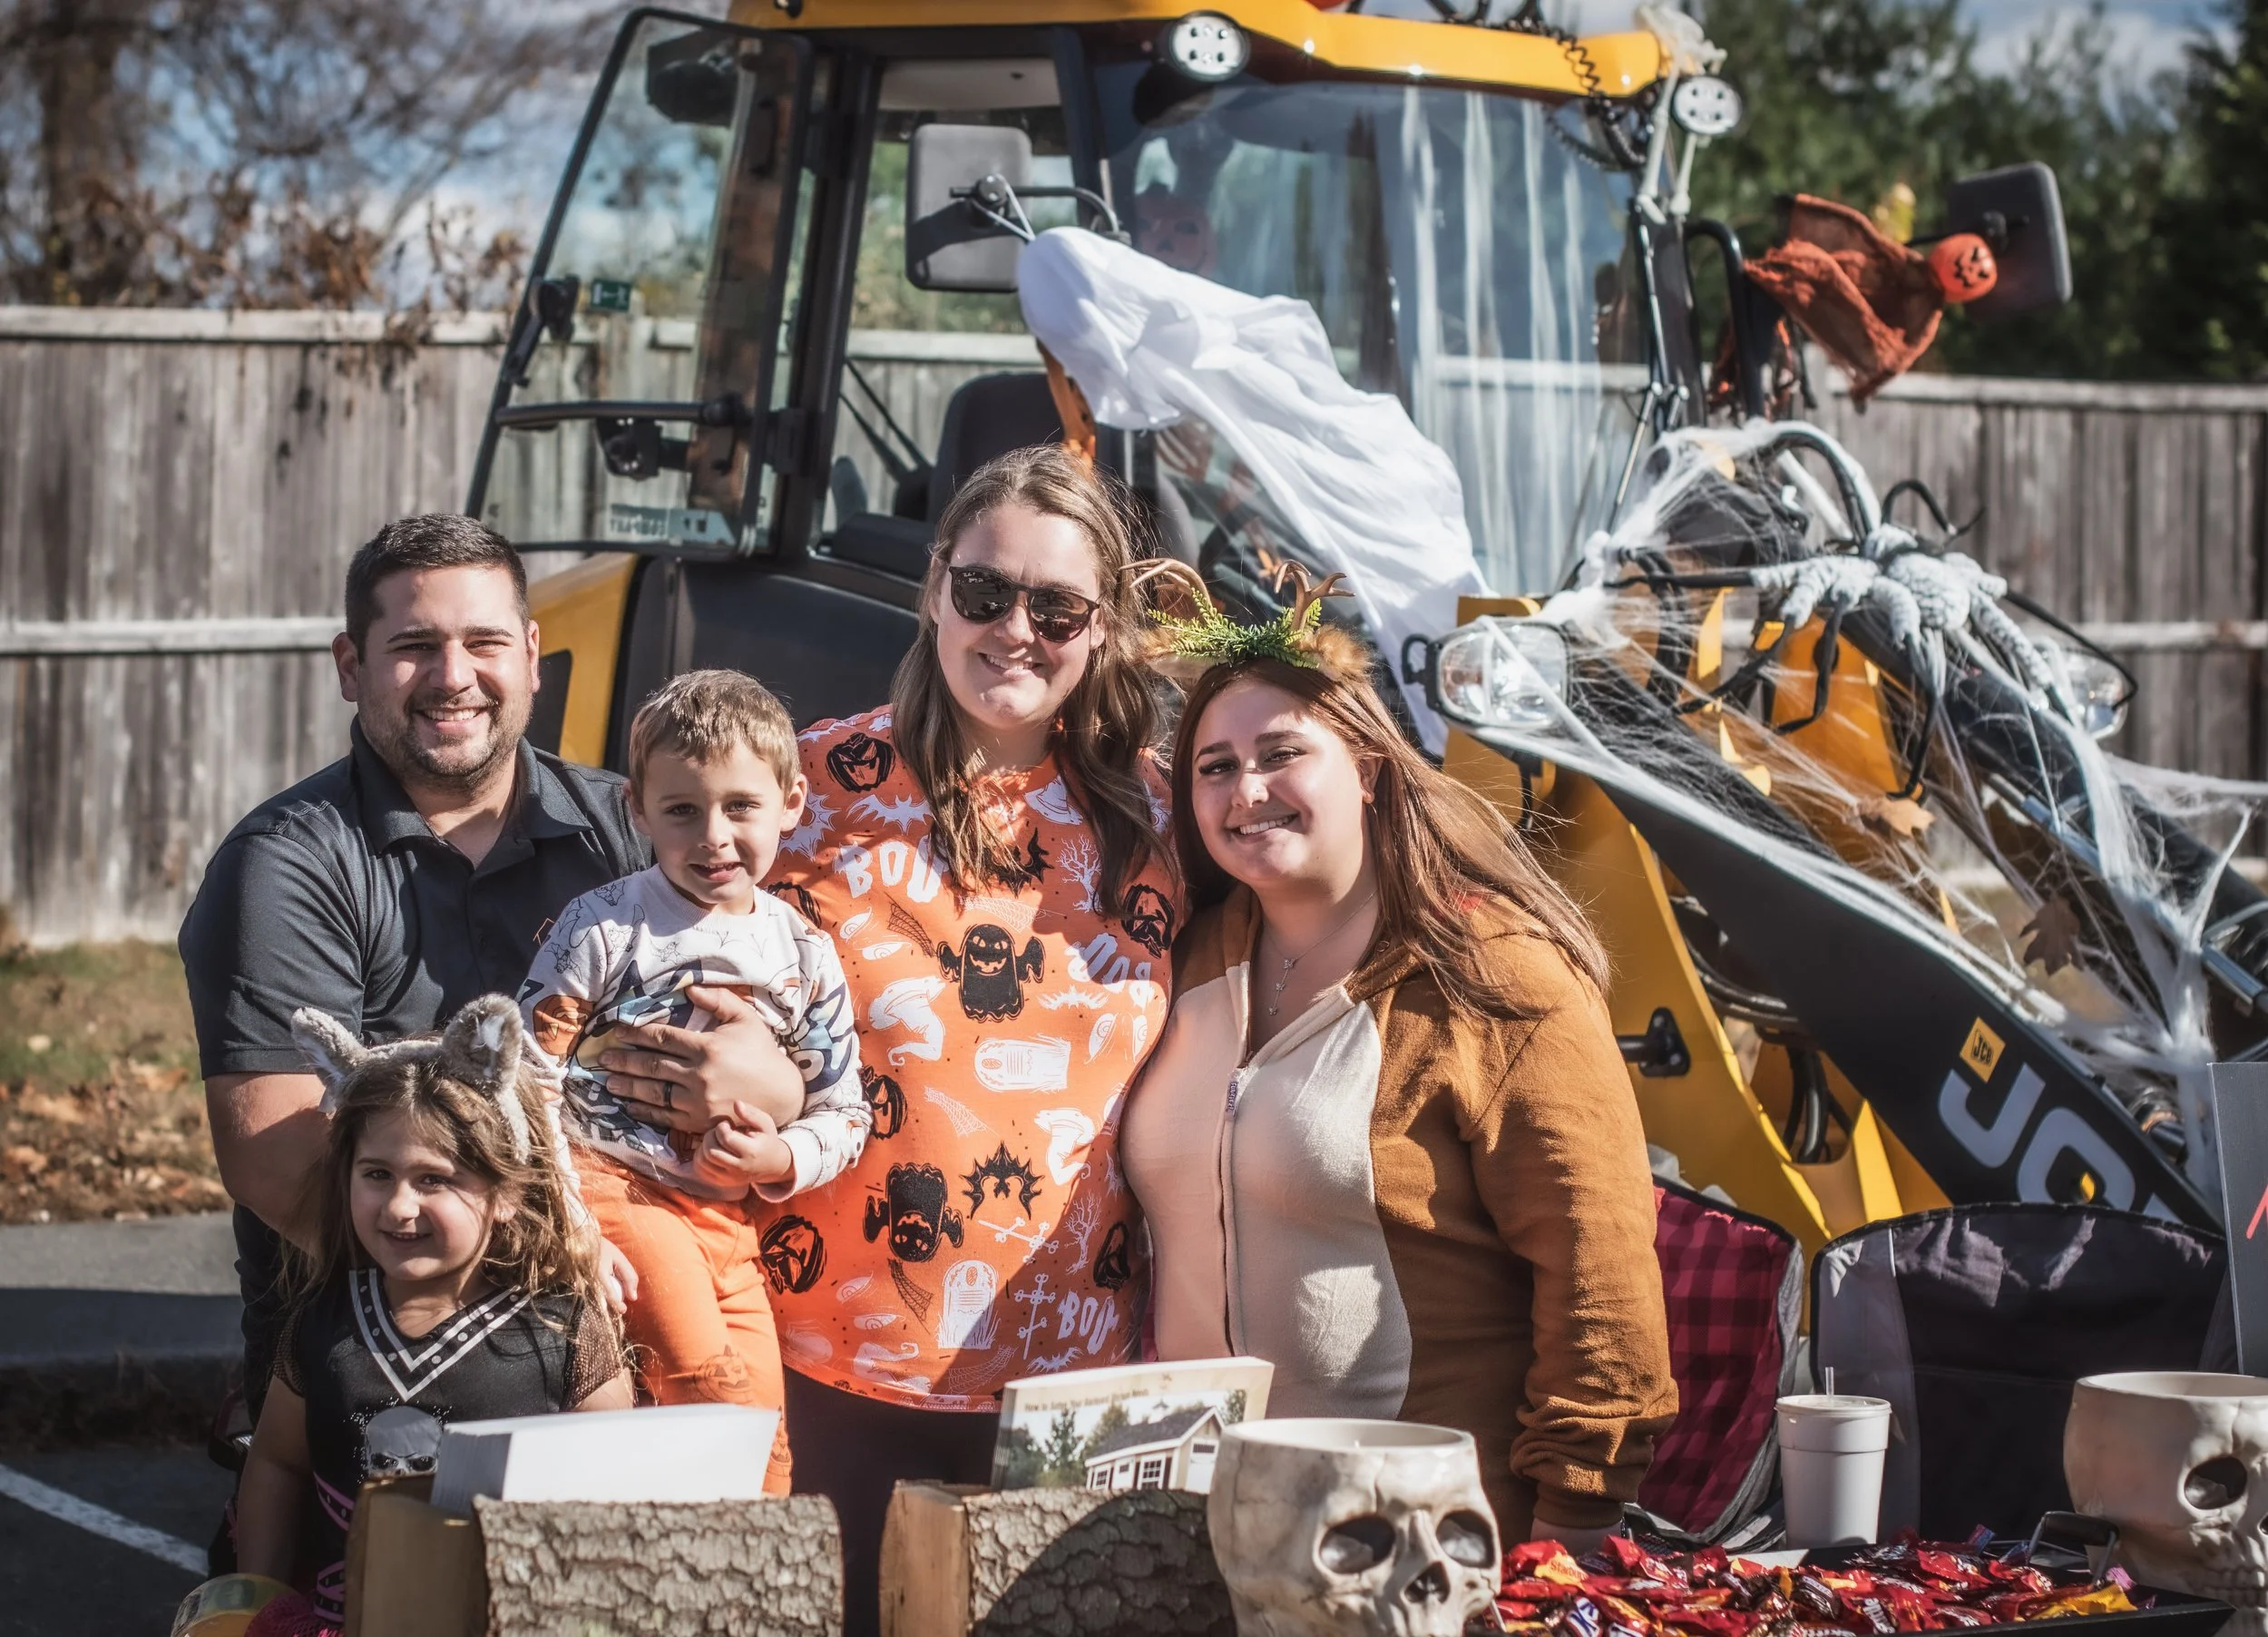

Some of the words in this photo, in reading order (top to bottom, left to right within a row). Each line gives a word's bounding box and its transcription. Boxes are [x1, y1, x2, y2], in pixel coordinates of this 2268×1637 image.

[832, 834, 950, 903] BOO
[1973, 1034, 1993, 1064] JCB
[1939, 1063, 2182, 1225] JC
[1057, 1289, 1119, 1355] BOO
